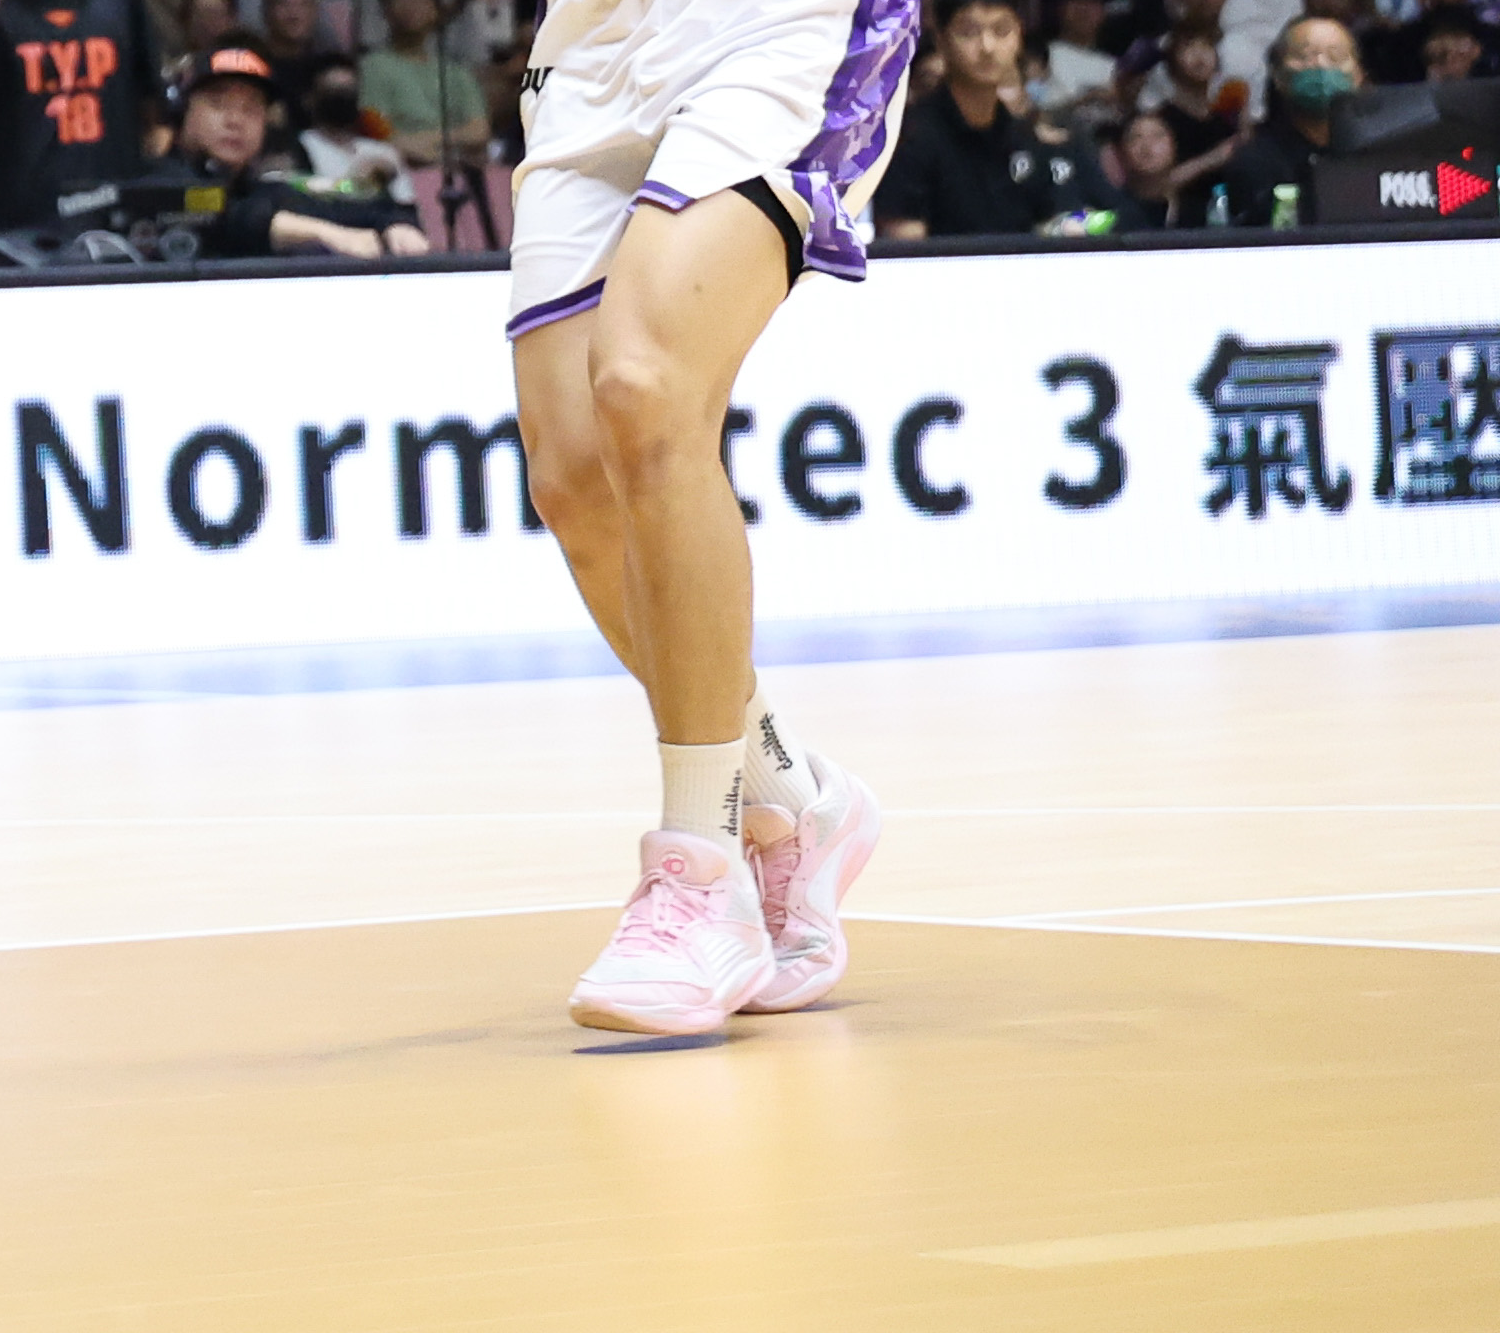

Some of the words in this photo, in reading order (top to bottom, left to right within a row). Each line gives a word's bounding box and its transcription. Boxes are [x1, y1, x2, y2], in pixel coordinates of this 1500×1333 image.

[1379, 171, 1438, 209] POSS.
[16, 397, 970, 557] Normtec
[1043, 357, 1126, 512] 3
